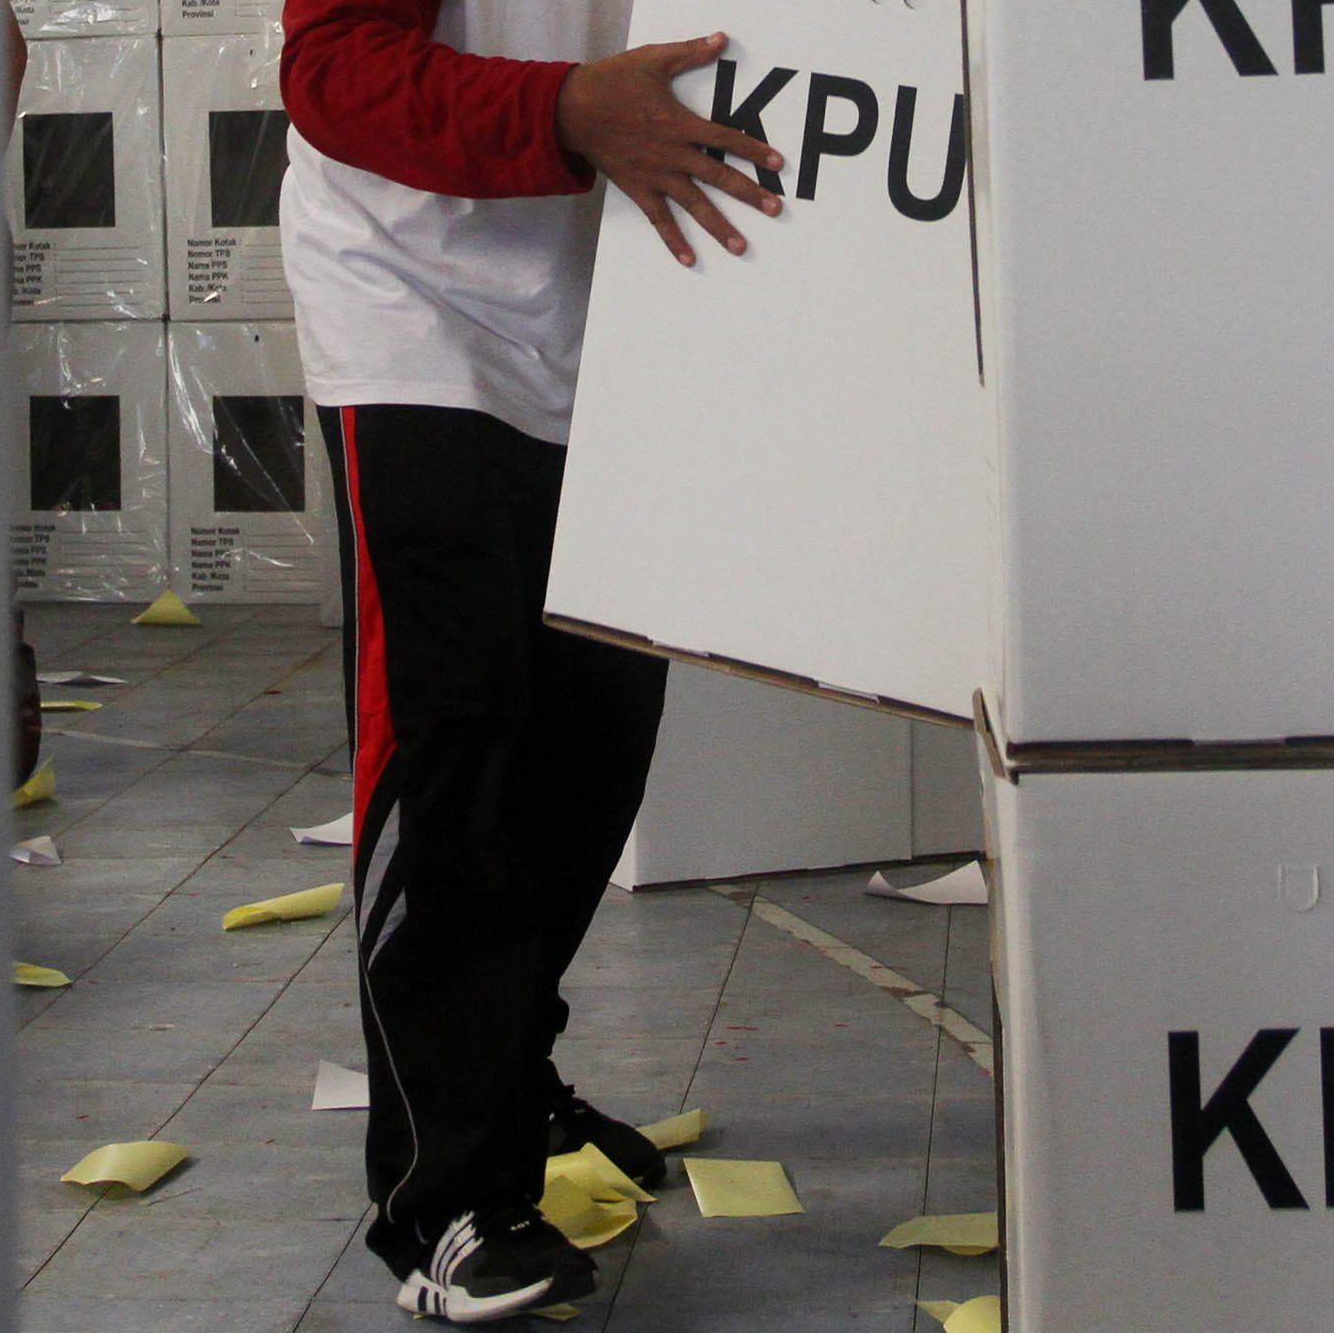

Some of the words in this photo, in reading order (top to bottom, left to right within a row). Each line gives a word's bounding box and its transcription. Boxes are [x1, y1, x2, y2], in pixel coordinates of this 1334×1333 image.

[707, 58, 967, 222] KPU
[187, 238, 212, 247] Nomor
[214, 237, 236, 246] Kotak
[188, 250, 212, 258] Nomor
[215, 249, 231, 258] TPS
[188, 261, 210, 269] Nama
[188, 273, 210, 281] Nama
[212, 272, 228, 280] PPK
[191, 527, 216, 535] Nomor
[218, 526, 240, 535] Kotak
[191, 538, 216, 546] Nomor
[218, 537, 235, 546] TPS
